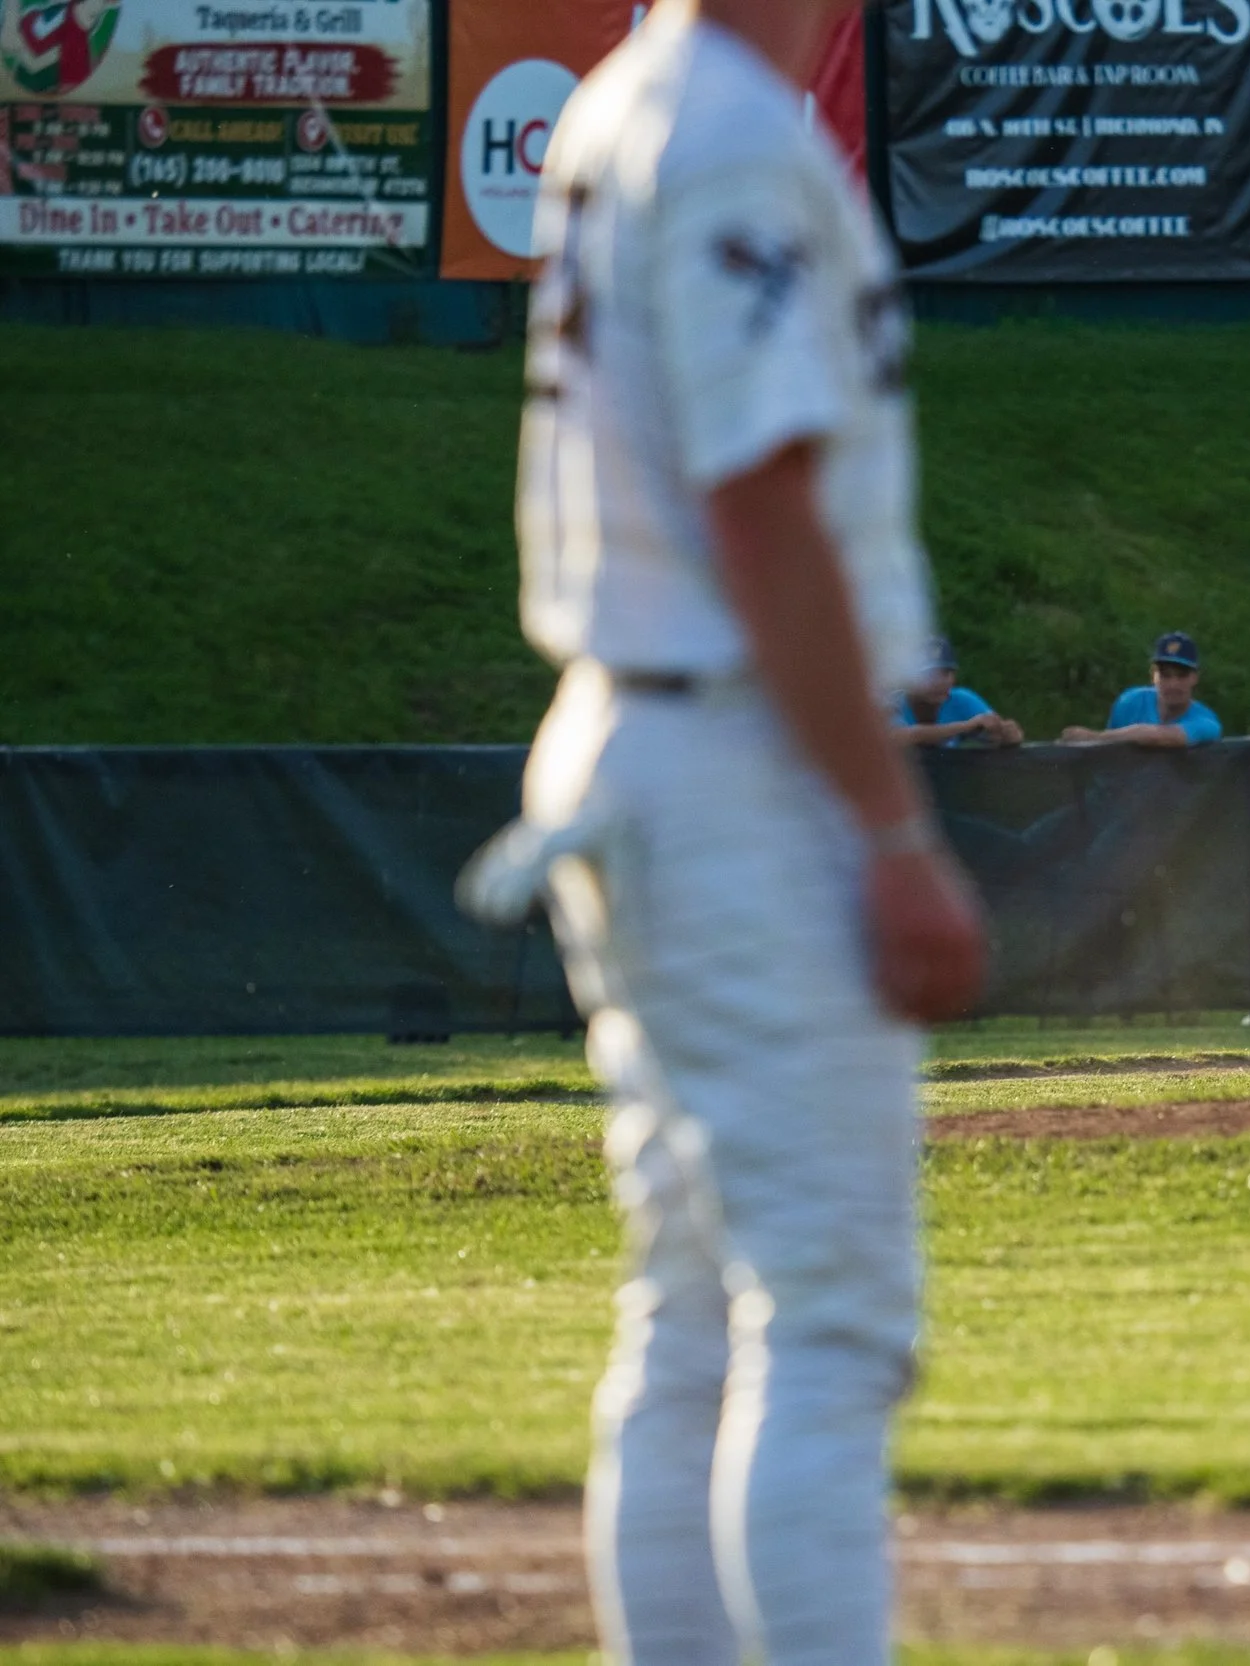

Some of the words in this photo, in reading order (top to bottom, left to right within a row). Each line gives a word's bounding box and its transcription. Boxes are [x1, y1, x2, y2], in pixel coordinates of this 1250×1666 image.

[294, 9, 311, 32] &
[315, 7, 363, 32] Grill
[174, 50, 279, 74] AUTHENTIC
[960, 65, 1029, 87] COFFEE
[1094, 65, 1200, 87] TAPROOM
[18, 203, 83, 237] Dine
[145, 205, 209, 237] Take
[215, 205, 264, 237] Out
[287, 205, 405, 246] Catering
[58, 249, 116, 272] THANK
[121, 249, 155, 272] YOU
[160, 249, 195, 272] FOR
[200, 249, 300, 273] SUPPORTING
